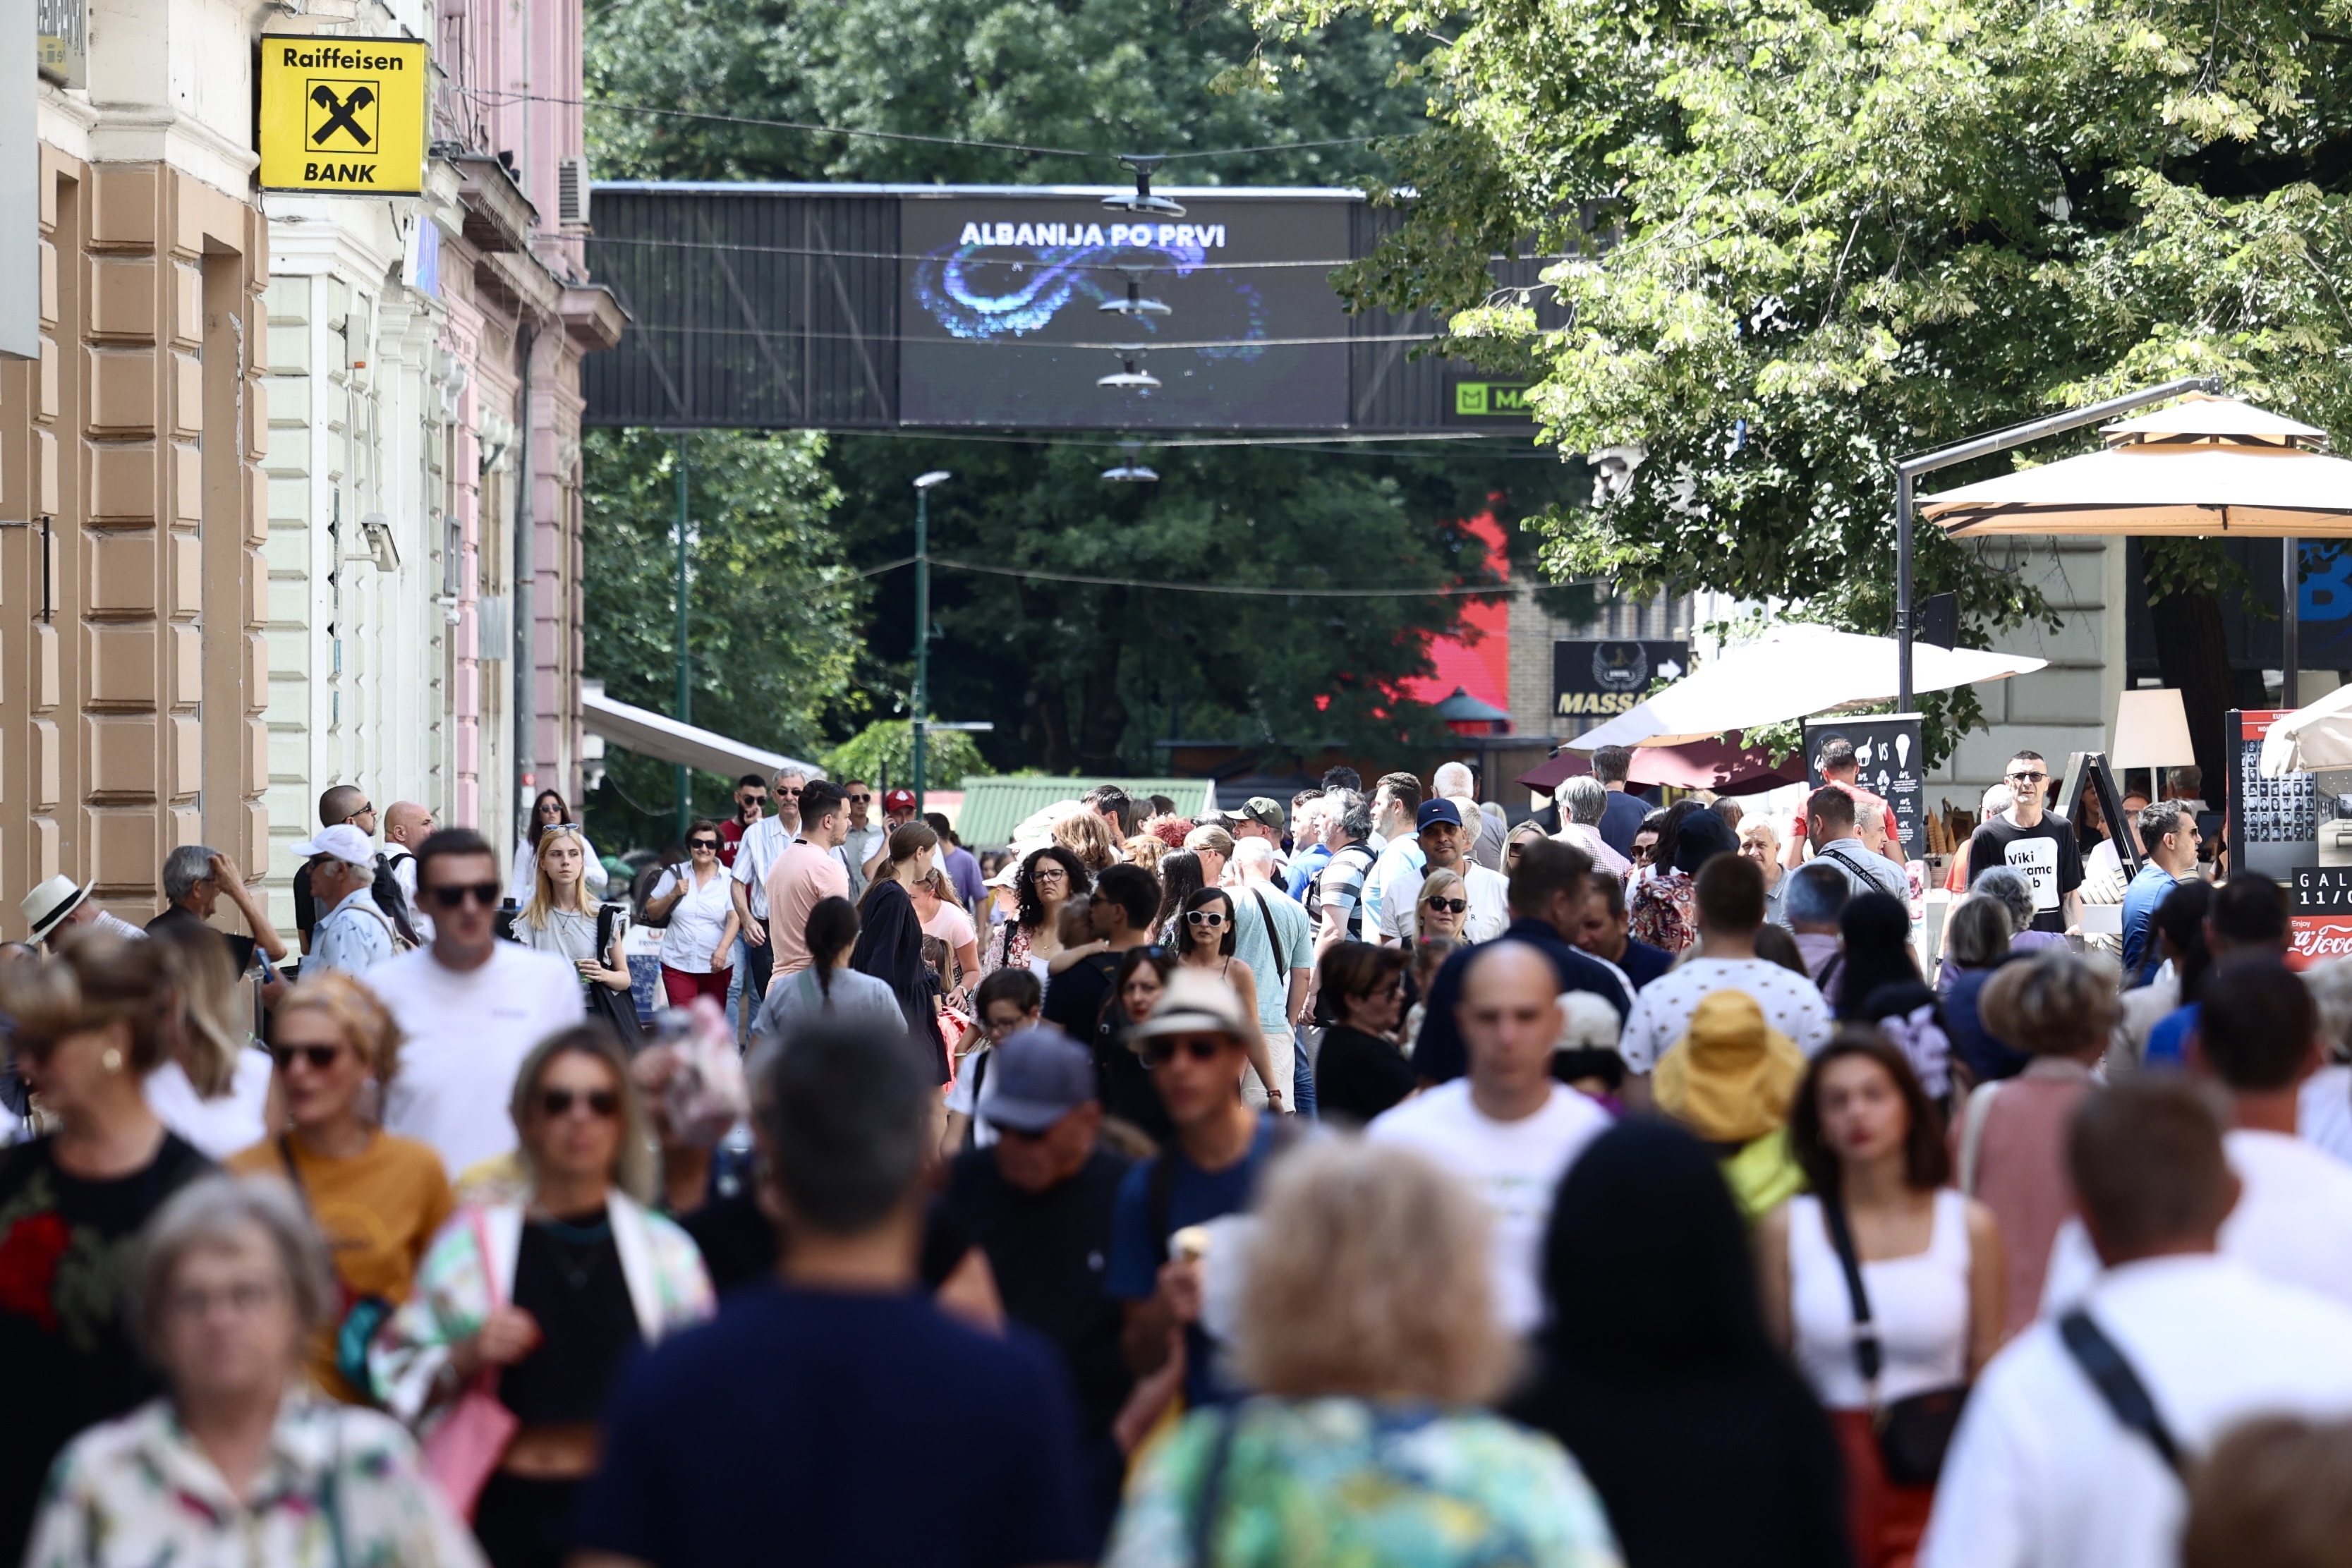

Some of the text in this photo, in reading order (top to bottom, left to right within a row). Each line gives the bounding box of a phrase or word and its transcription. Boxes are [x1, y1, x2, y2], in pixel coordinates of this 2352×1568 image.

[284, 47, 403, 71] Raiffeisen
[304, 163, 377, 183] BANK
[960, 221, 1226, 248] ALBANIJA PO PRVI
[1878, 743, 1889, 761] VS
[2008, 851, 2034, 865] Viki
[1838, 854, 1883, 892] UNDER ARMO
[2022, 866, 2052, 876] ama
[2291, 920, 2310, 928] Enjoy
